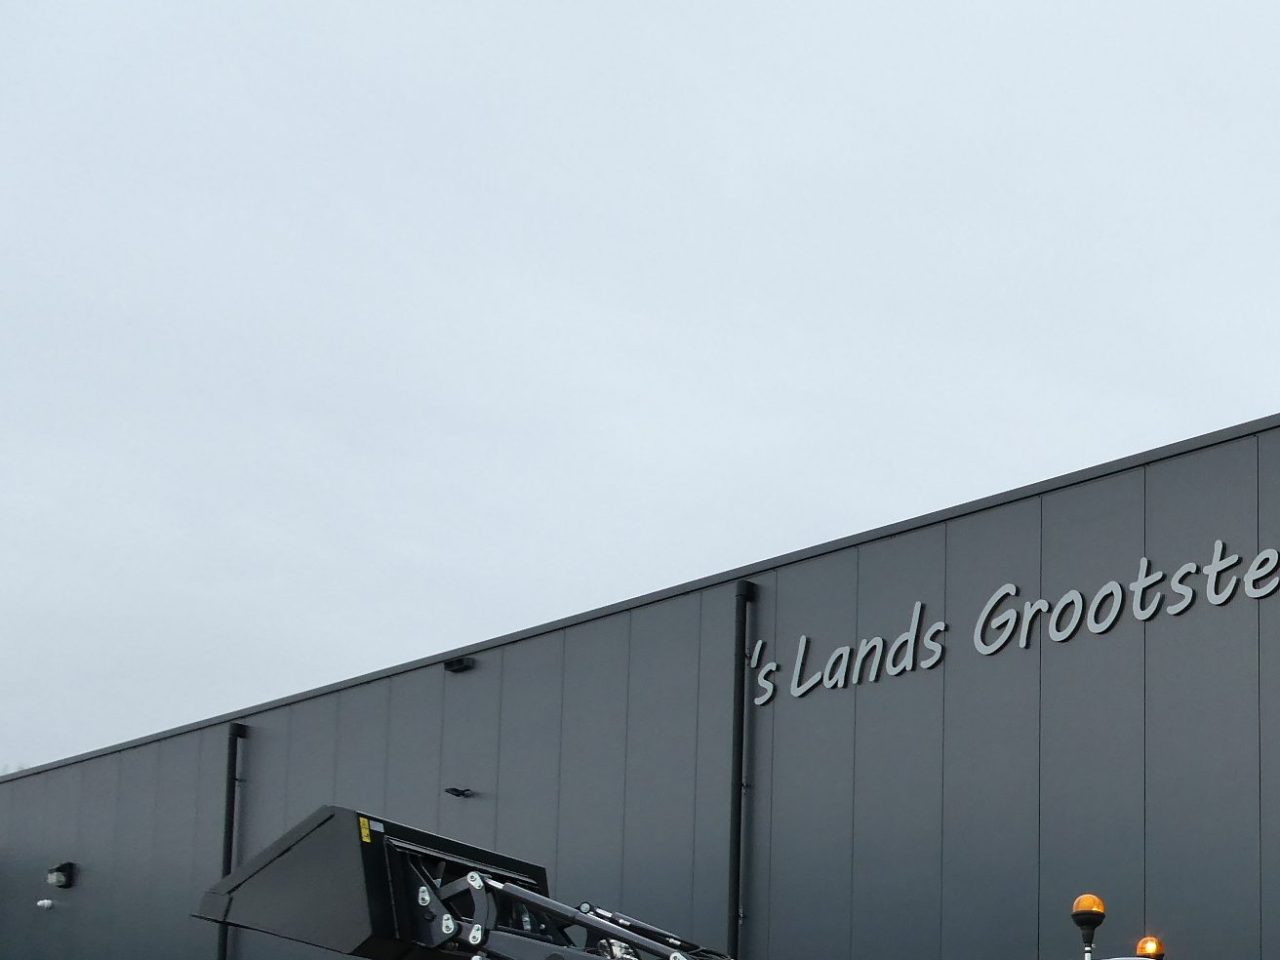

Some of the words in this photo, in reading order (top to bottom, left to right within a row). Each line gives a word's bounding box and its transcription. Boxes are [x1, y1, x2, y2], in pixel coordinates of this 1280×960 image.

[750, 639, 779, 706] 's
[790, 600, 946, 698] Lands
[973, 538, 1280, 656] Grootste
